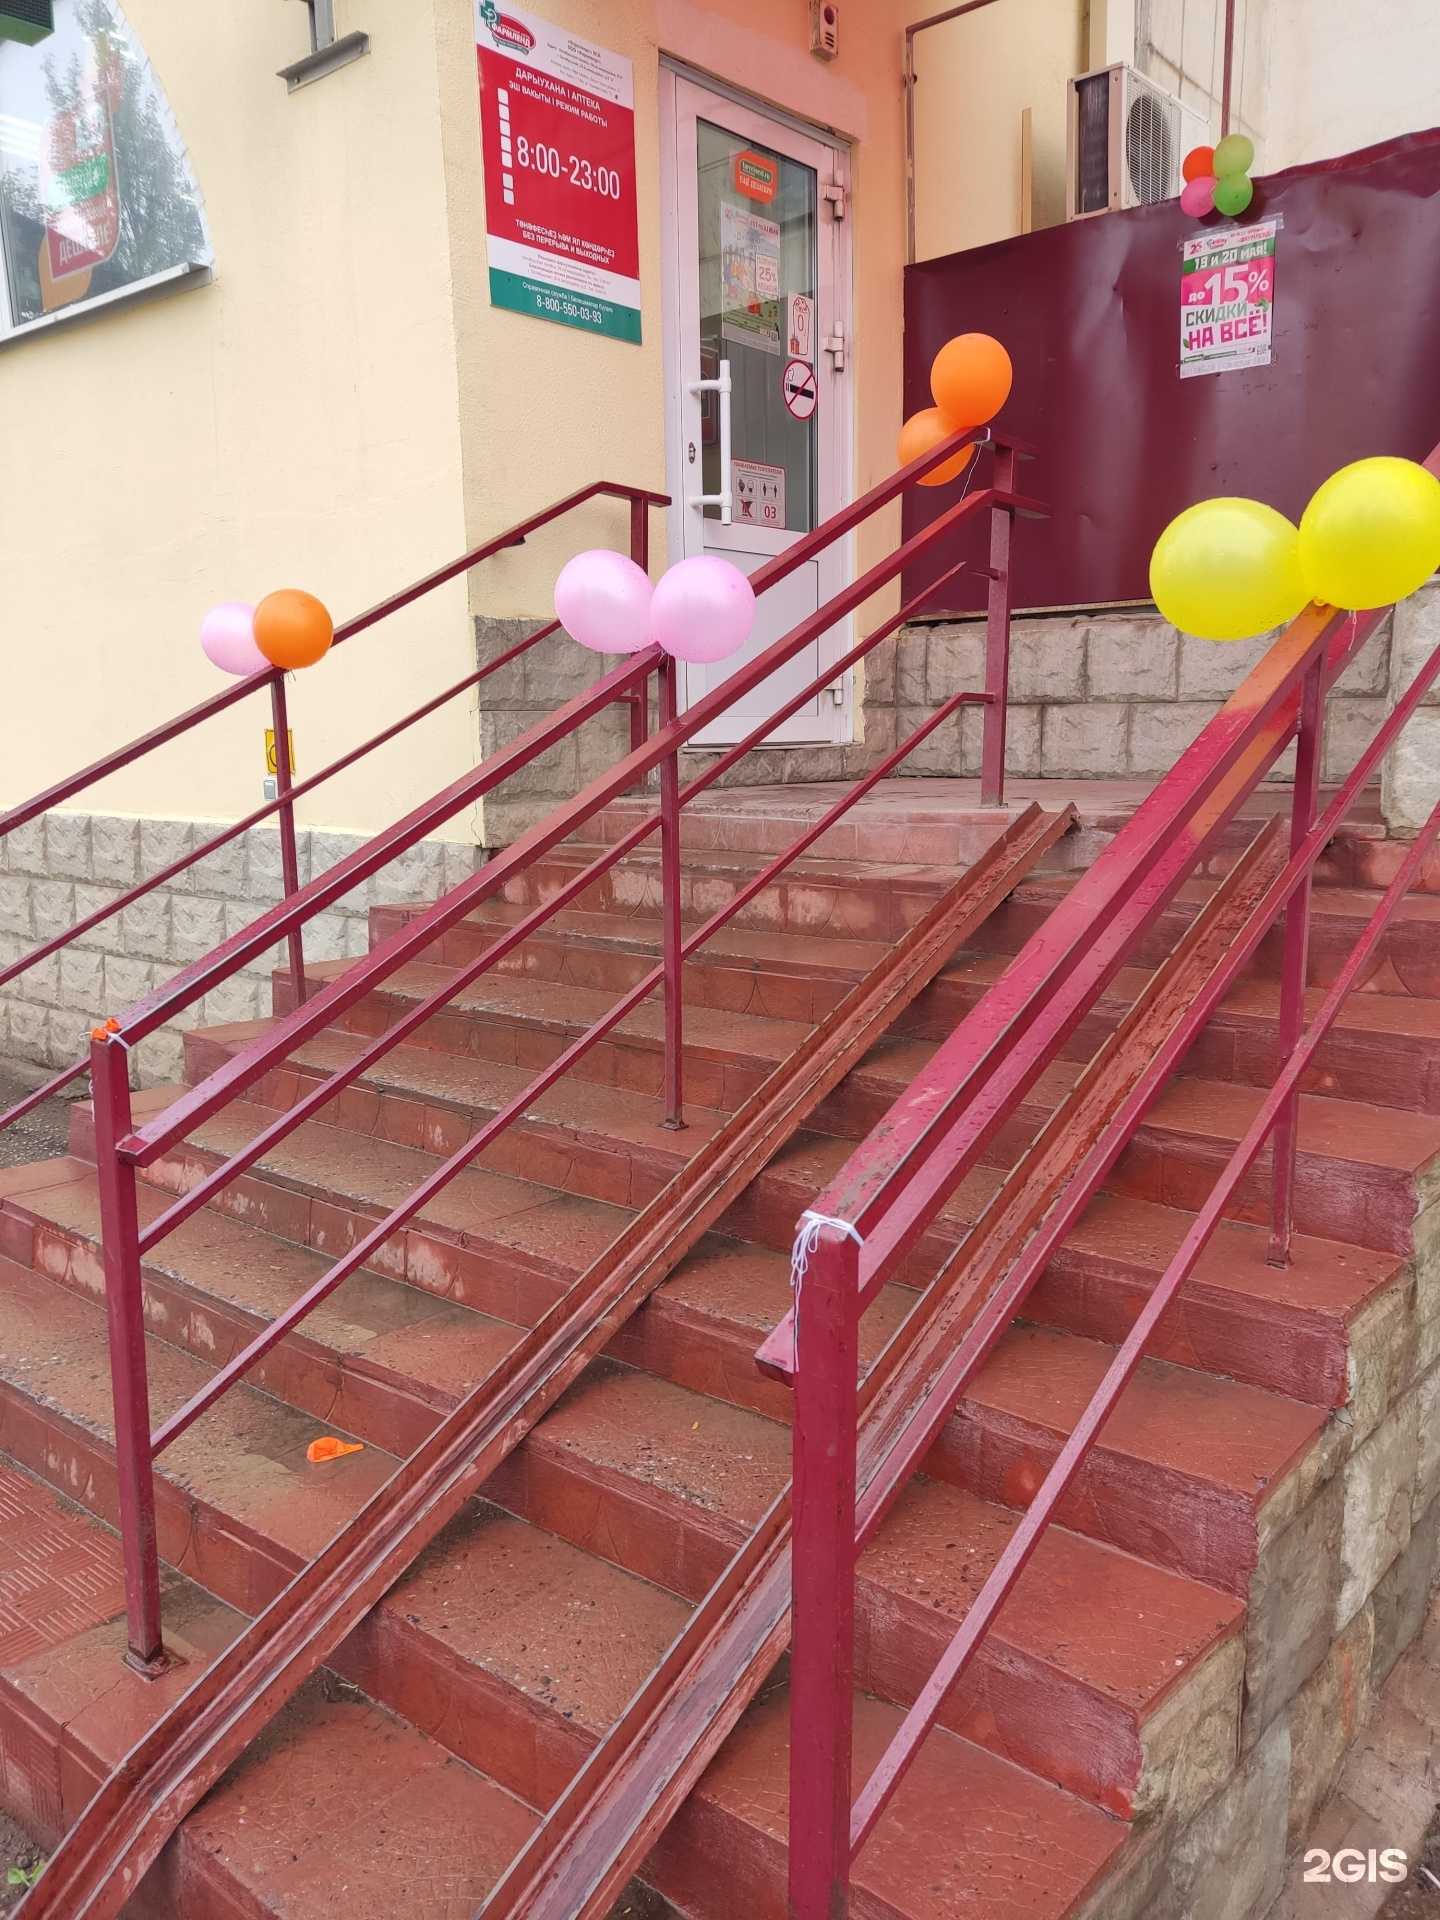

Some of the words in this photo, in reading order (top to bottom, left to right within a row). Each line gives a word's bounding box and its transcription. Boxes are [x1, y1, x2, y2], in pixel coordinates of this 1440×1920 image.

[509, 80, 521, 92] ЭШ
[555, 100, 580, 117] РЕЖИМ
[580, 109, 608, 129] РАБОТЫ
[515, 67, 566, 97] ДАРЫУХАНА
[572, 92, 601, 111] АПТЕКА
[517, 135, 620, 200] 8:00-23:00
[522, 230, 535, 241] БЕЗ
[536, 234, 569, 252] ПЕРЕРЫВА
[576, 246, 609, 265] ВЫХОДНЫХ
[1194, 257, 1207, 271] 19
[1222, 249, 1238, 264] 20
[1205, 264, 1269, 305] 15%
[536, 295, 602, 324] 8-800-550-03-93
[1186, 302, 1247, 328] СКИДКИ
[1188, 326, 1214, 350] НА
[1220, 309, 1268, 343] ВСЁ!
[764, 505, 777, 519] 03
